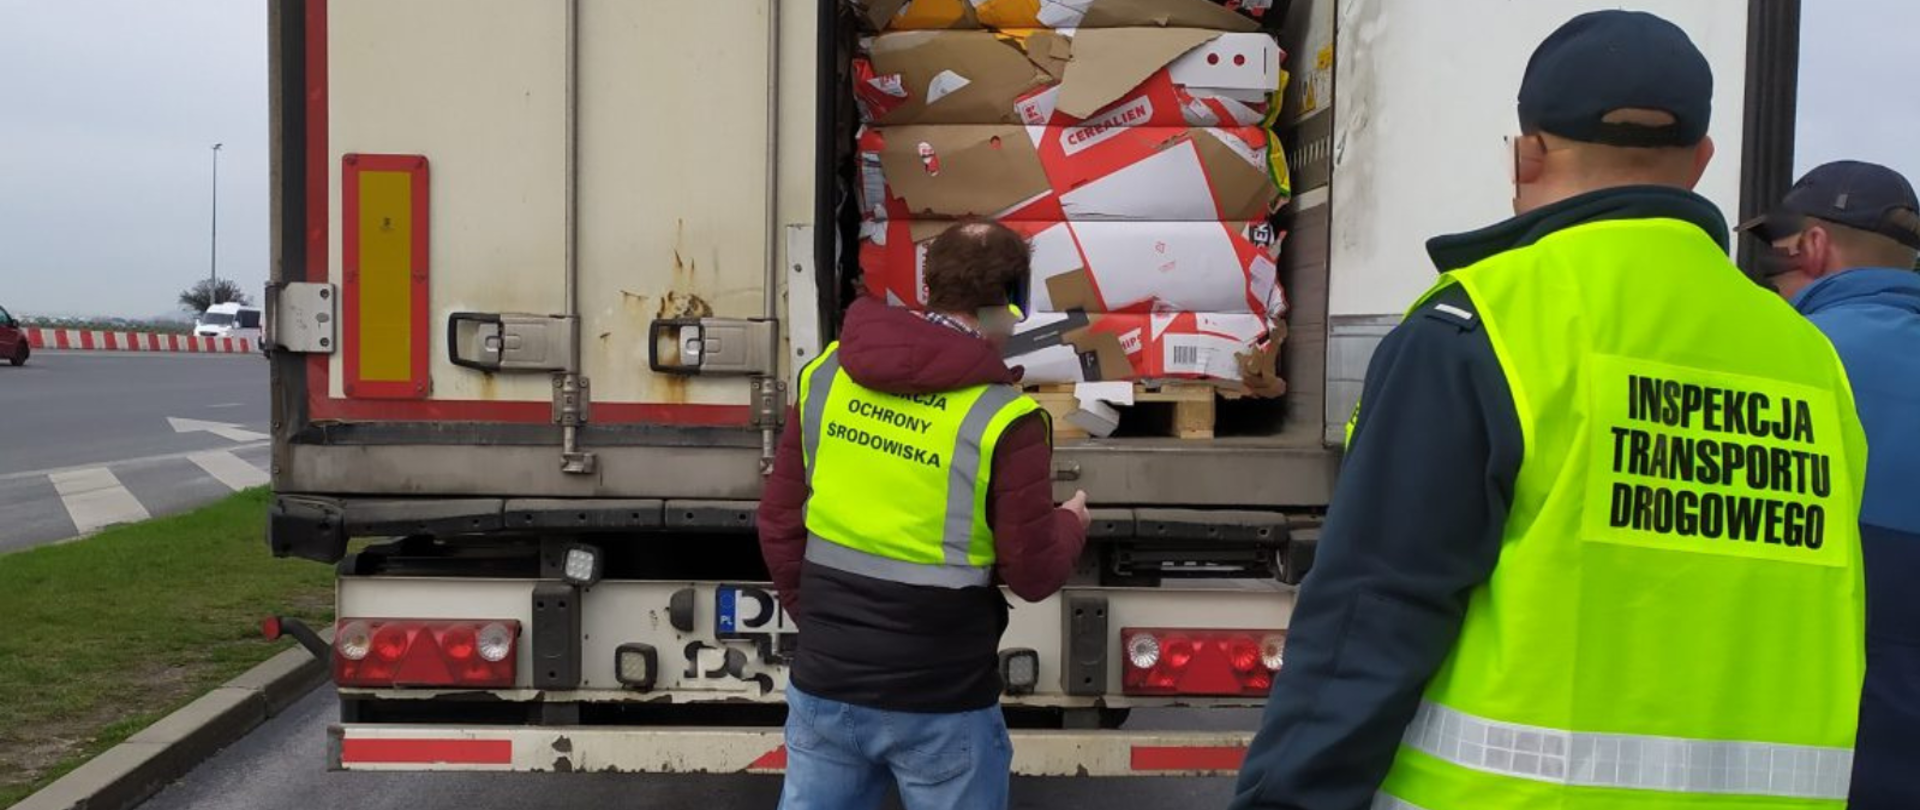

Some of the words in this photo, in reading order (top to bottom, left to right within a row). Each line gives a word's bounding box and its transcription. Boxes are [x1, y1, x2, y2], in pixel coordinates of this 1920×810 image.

[1067, 104, 1147, 145] CEREALIEN
[848, 399, 933, 435] OCHRONY
[1628, 375, 1815, 444] INSPEKCJA
[827, 421, 942, 468] ŚRODOWISKA
[1610, 426, 1832, 498] TRANSPORTU
[1610, 483, 1825, 550] DROGOWEGO
[720, 615, 733, 626] PL
